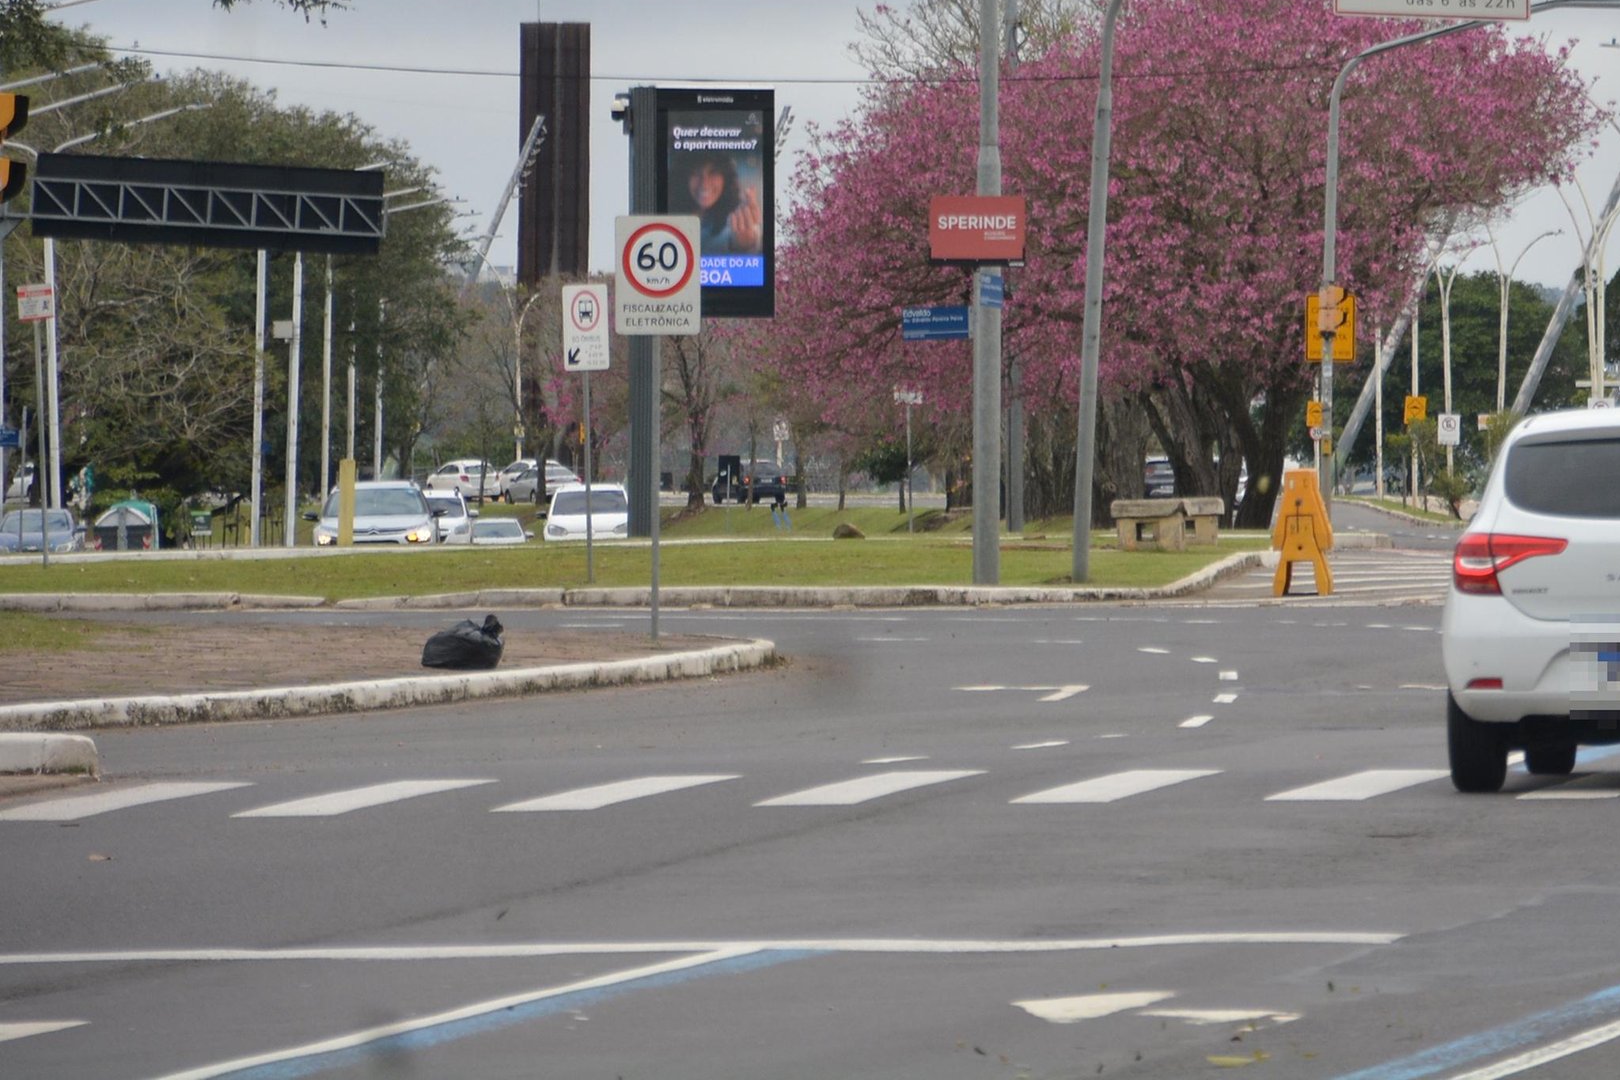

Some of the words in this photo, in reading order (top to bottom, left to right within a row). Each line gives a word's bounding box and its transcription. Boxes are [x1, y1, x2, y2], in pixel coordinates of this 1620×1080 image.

[673, 126, 699, 139] Quer
[700, 126, 742, 137] decorar
[673, 141, 681, 150] o
[682, 139, 758, 151] apartamento?
[938, 215, 1017, 230] SPERINDE
[637, 241, 679, 271] 60
[729, 258, 743, 268] DO
[745, 258, 760, 268] AR
[646, 276, 670, 285] km/h
[622, 303, 694, 315] FISCALIZAÇÃO
[903, 308, 932, 319] Edvaldo
[625, 315, 690, 327] ELETRÔNICA
